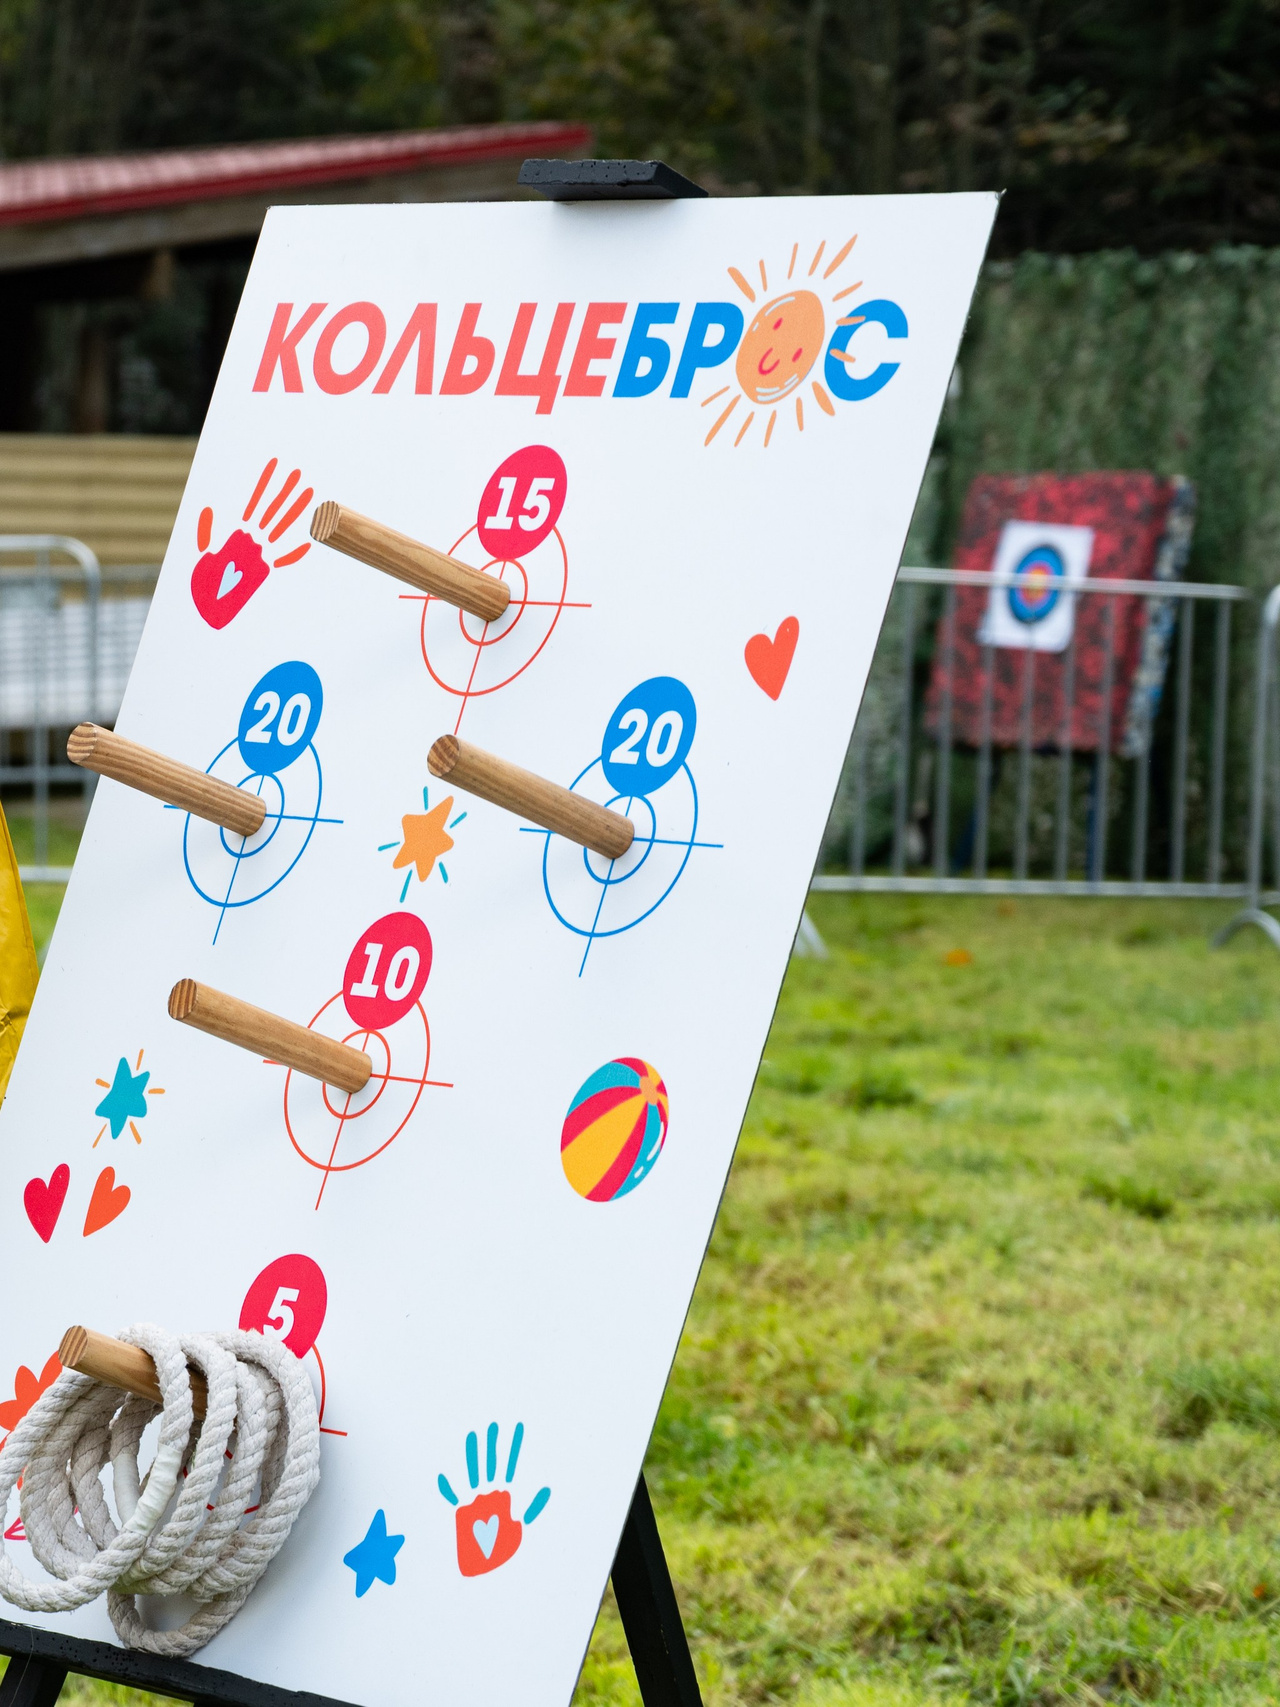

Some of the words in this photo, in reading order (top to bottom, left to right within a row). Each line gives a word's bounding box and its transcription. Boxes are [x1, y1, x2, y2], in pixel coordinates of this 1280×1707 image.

[484, 476, 555, 532] 15
[245, 690, 312, 747] 20
[609, 707, 684, 768] 20
[349, 942, 421, 1002] 10
[262, 1286, 300, 1342] 5
